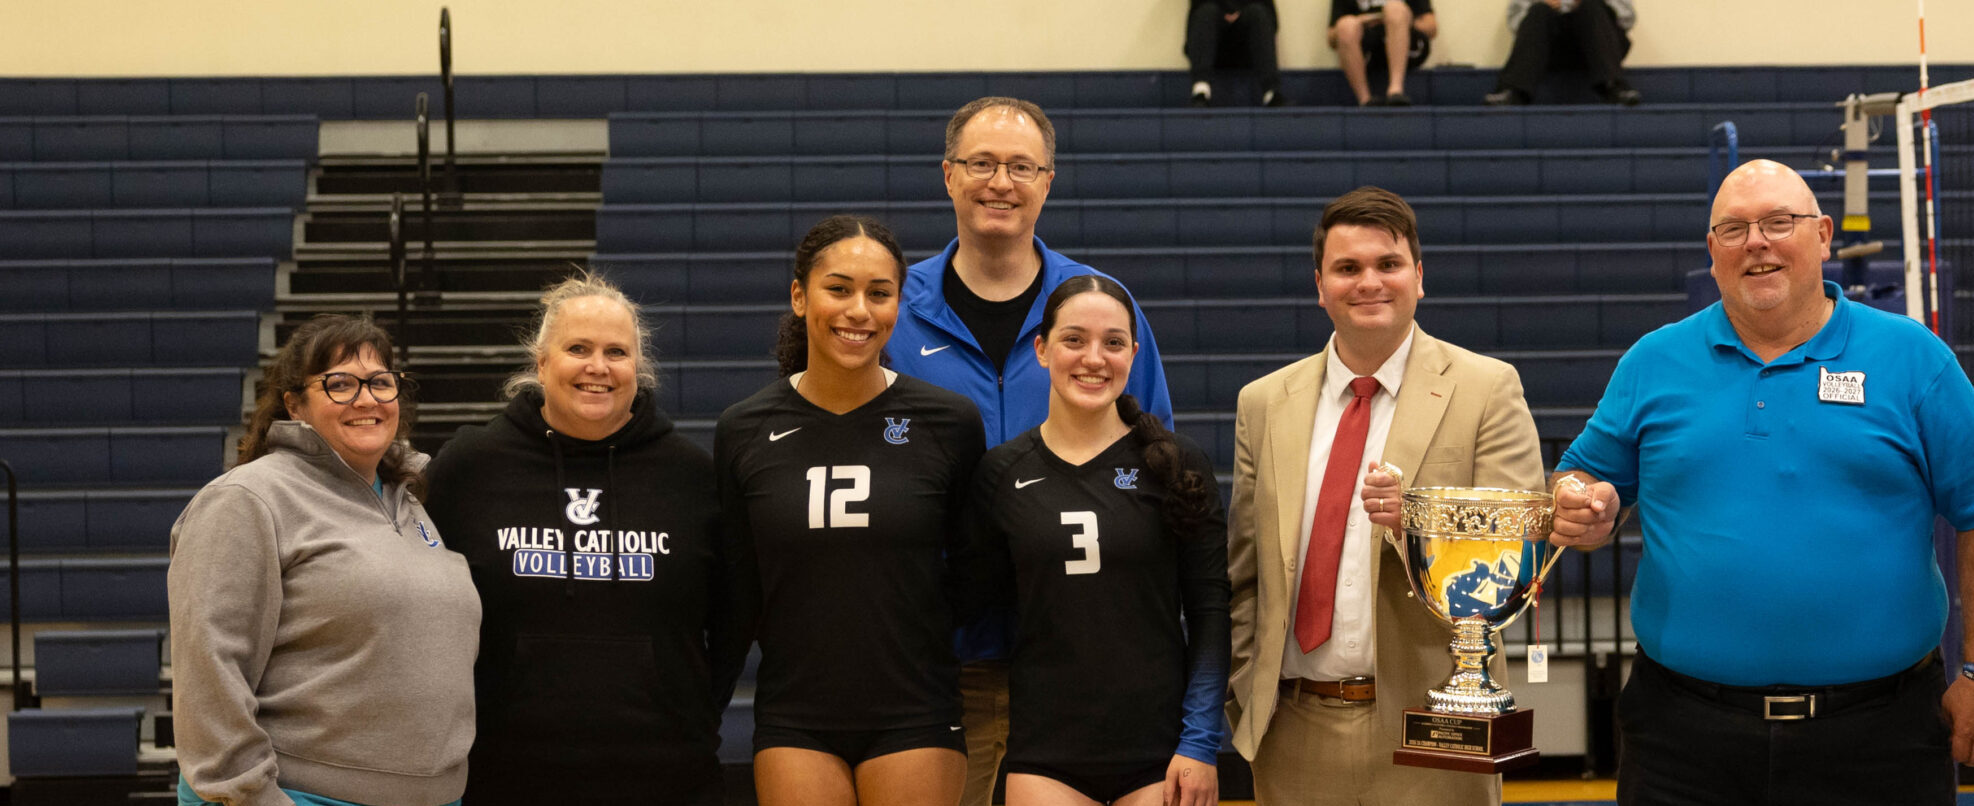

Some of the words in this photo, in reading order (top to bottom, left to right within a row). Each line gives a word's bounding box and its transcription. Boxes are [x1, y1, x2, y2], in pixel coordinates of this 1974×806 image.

[1823, 381, 1860, 389] VOLLEYBALL
[1826, 375, 1857, 383] OSAA
[1823, 393, 1860, 401] OFFICIAL
[806, 465, 871, 529] 12
[498, 527, 564, 551] VALLEY
[1060, 511, 1101, 575] 3
